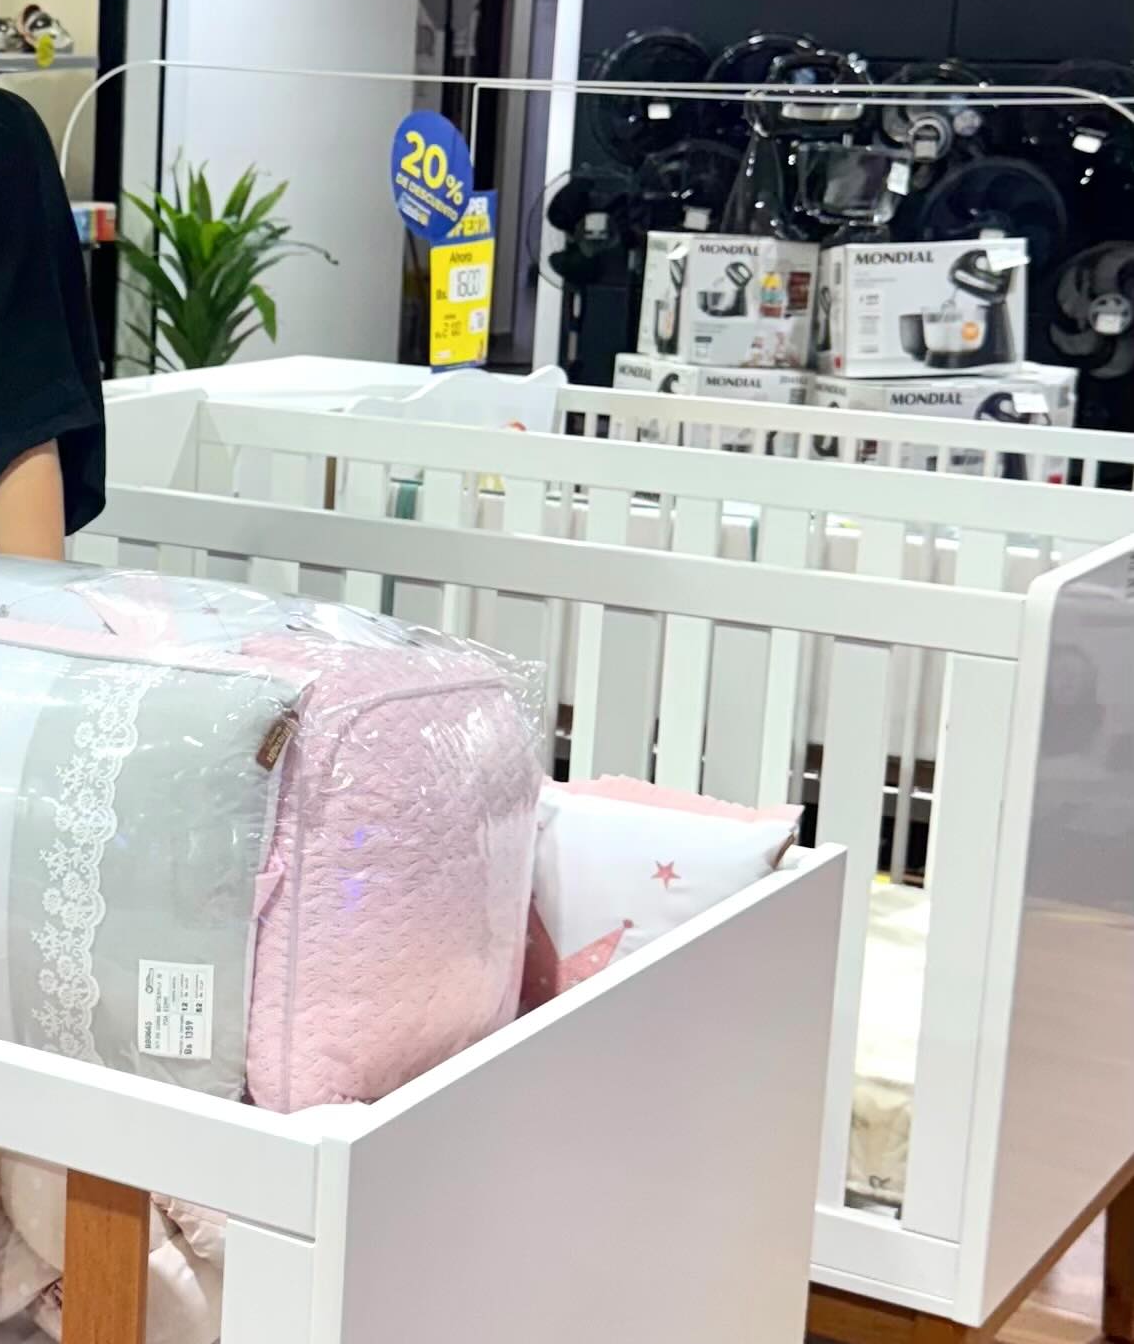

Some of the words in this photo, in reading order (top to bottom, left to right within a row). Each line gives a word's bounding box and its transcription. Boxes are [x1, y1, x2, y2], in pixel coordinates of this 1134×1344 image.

[401, 131, 464, 206] 20%
[698, 244, 760, 257] MONDIAL
[854, 250, 935, 265] MONDIAL
[706, 376, 762, 389] MONDIAL
[890, 392, 964, 406] MONDIAL
